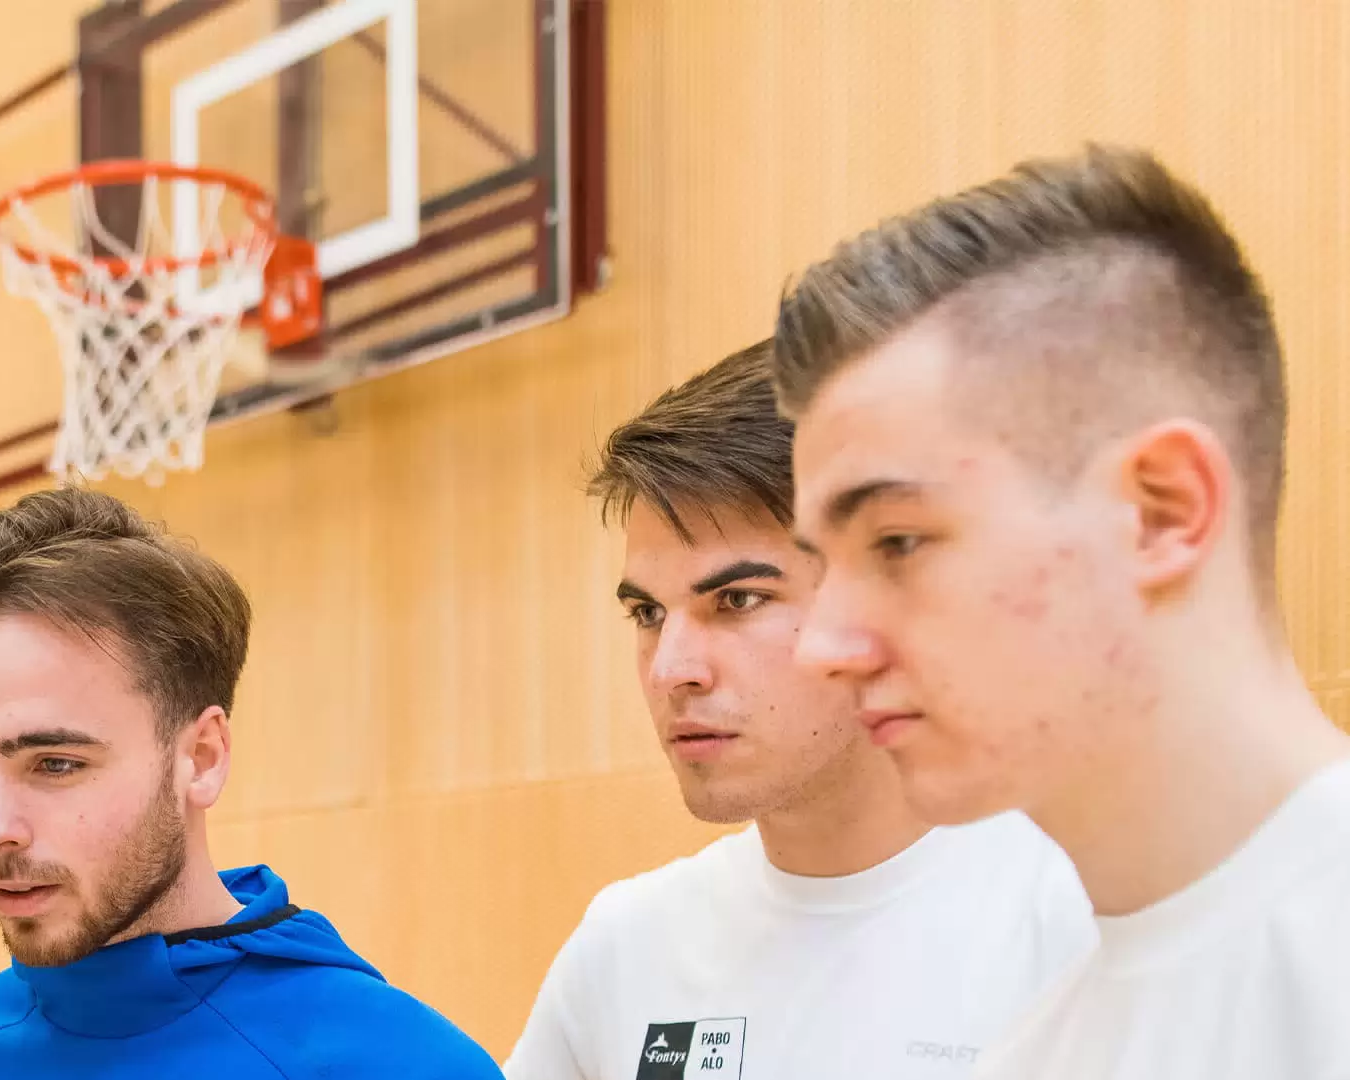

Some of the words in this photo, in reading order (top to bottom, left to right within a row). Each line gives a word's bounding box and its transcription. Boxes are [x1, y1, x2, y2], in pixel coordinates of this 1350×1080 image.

[701, 1032, 730, 1045] PABO
[645, 1050, 687, 1066] Fontys
[701, 1056, 724, 1070] ALO
